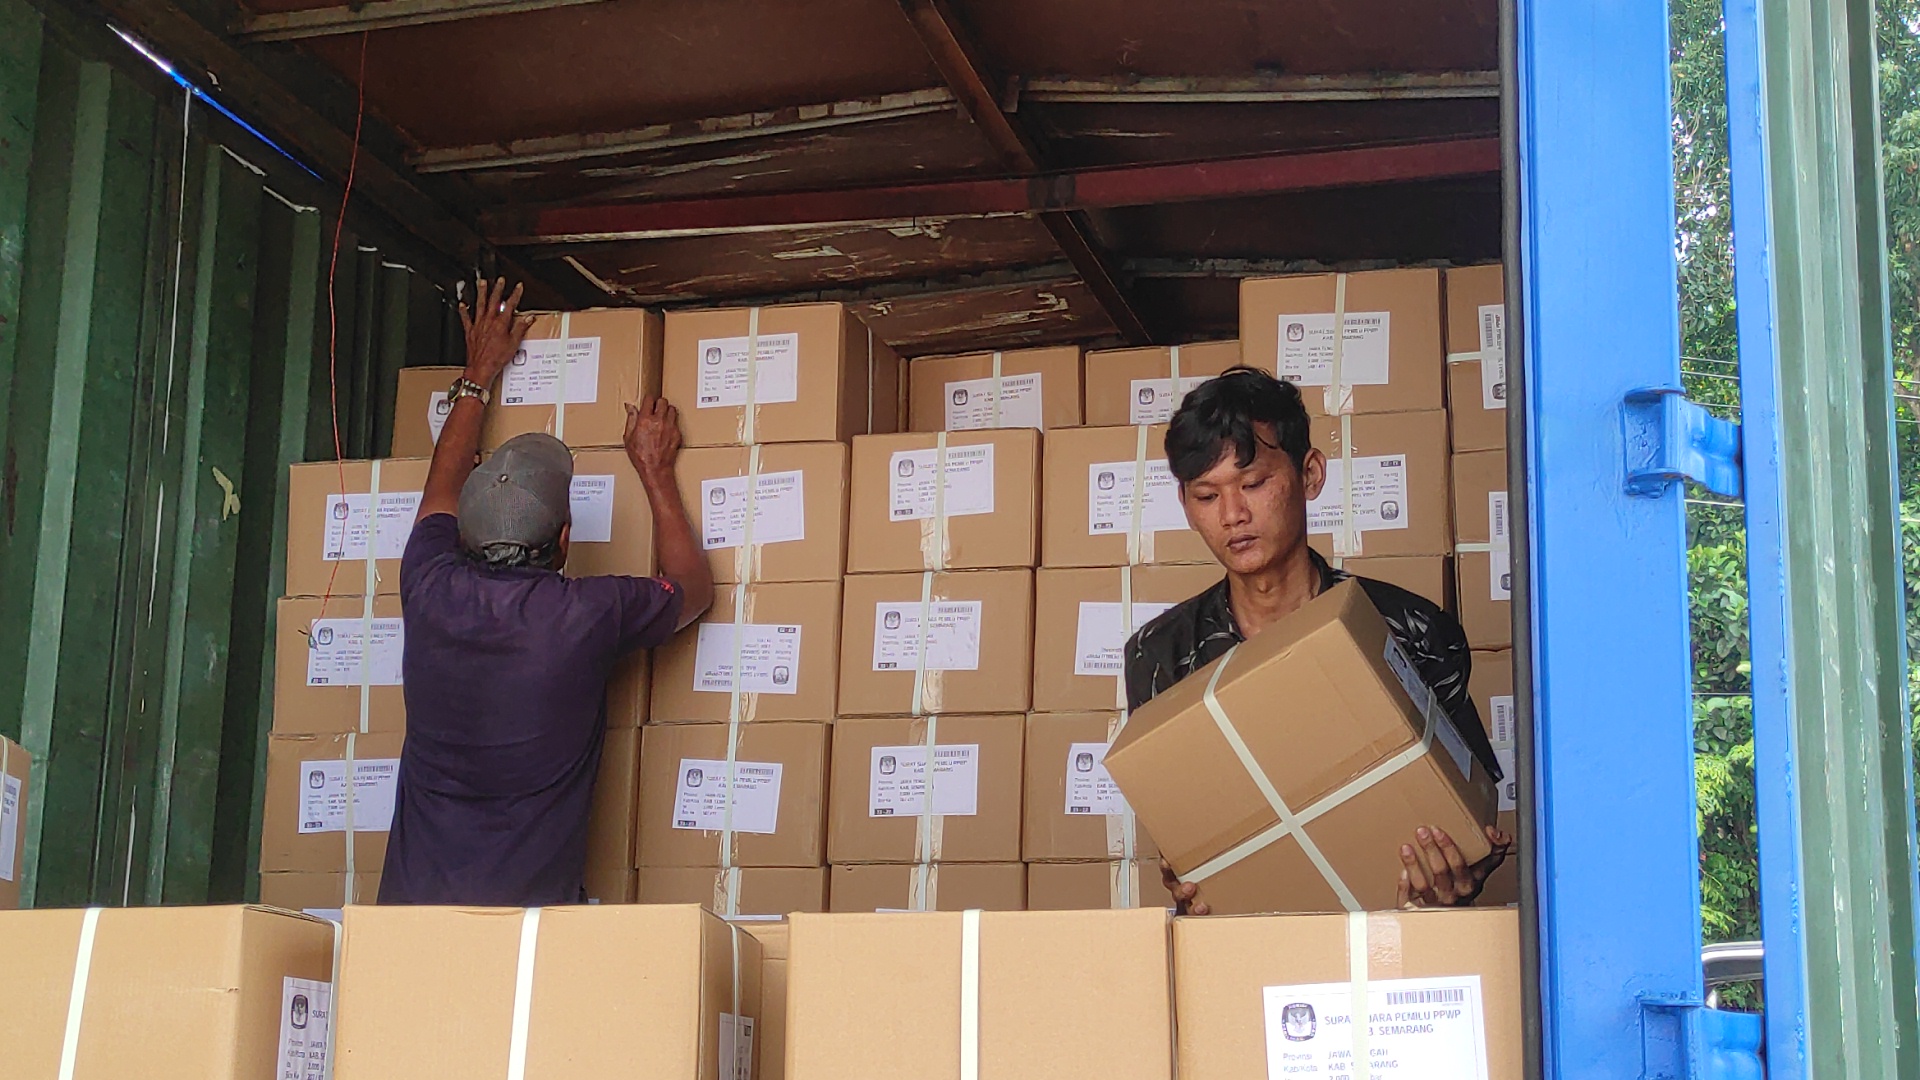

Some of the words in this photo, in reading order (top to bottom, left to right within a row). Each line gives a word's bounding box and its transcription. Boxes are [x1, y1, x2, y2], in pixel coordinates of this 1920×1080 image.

[1324, 1014, 1351, 1025] SURA
[1394, 1010, 1431, 1021] PEMILU
[1433, 1009, 1461, 1019] PPWP
[1378, 1023, 1434, 1036] SEMARANG
[1327, 1049, 1351, 1059] JAWA
